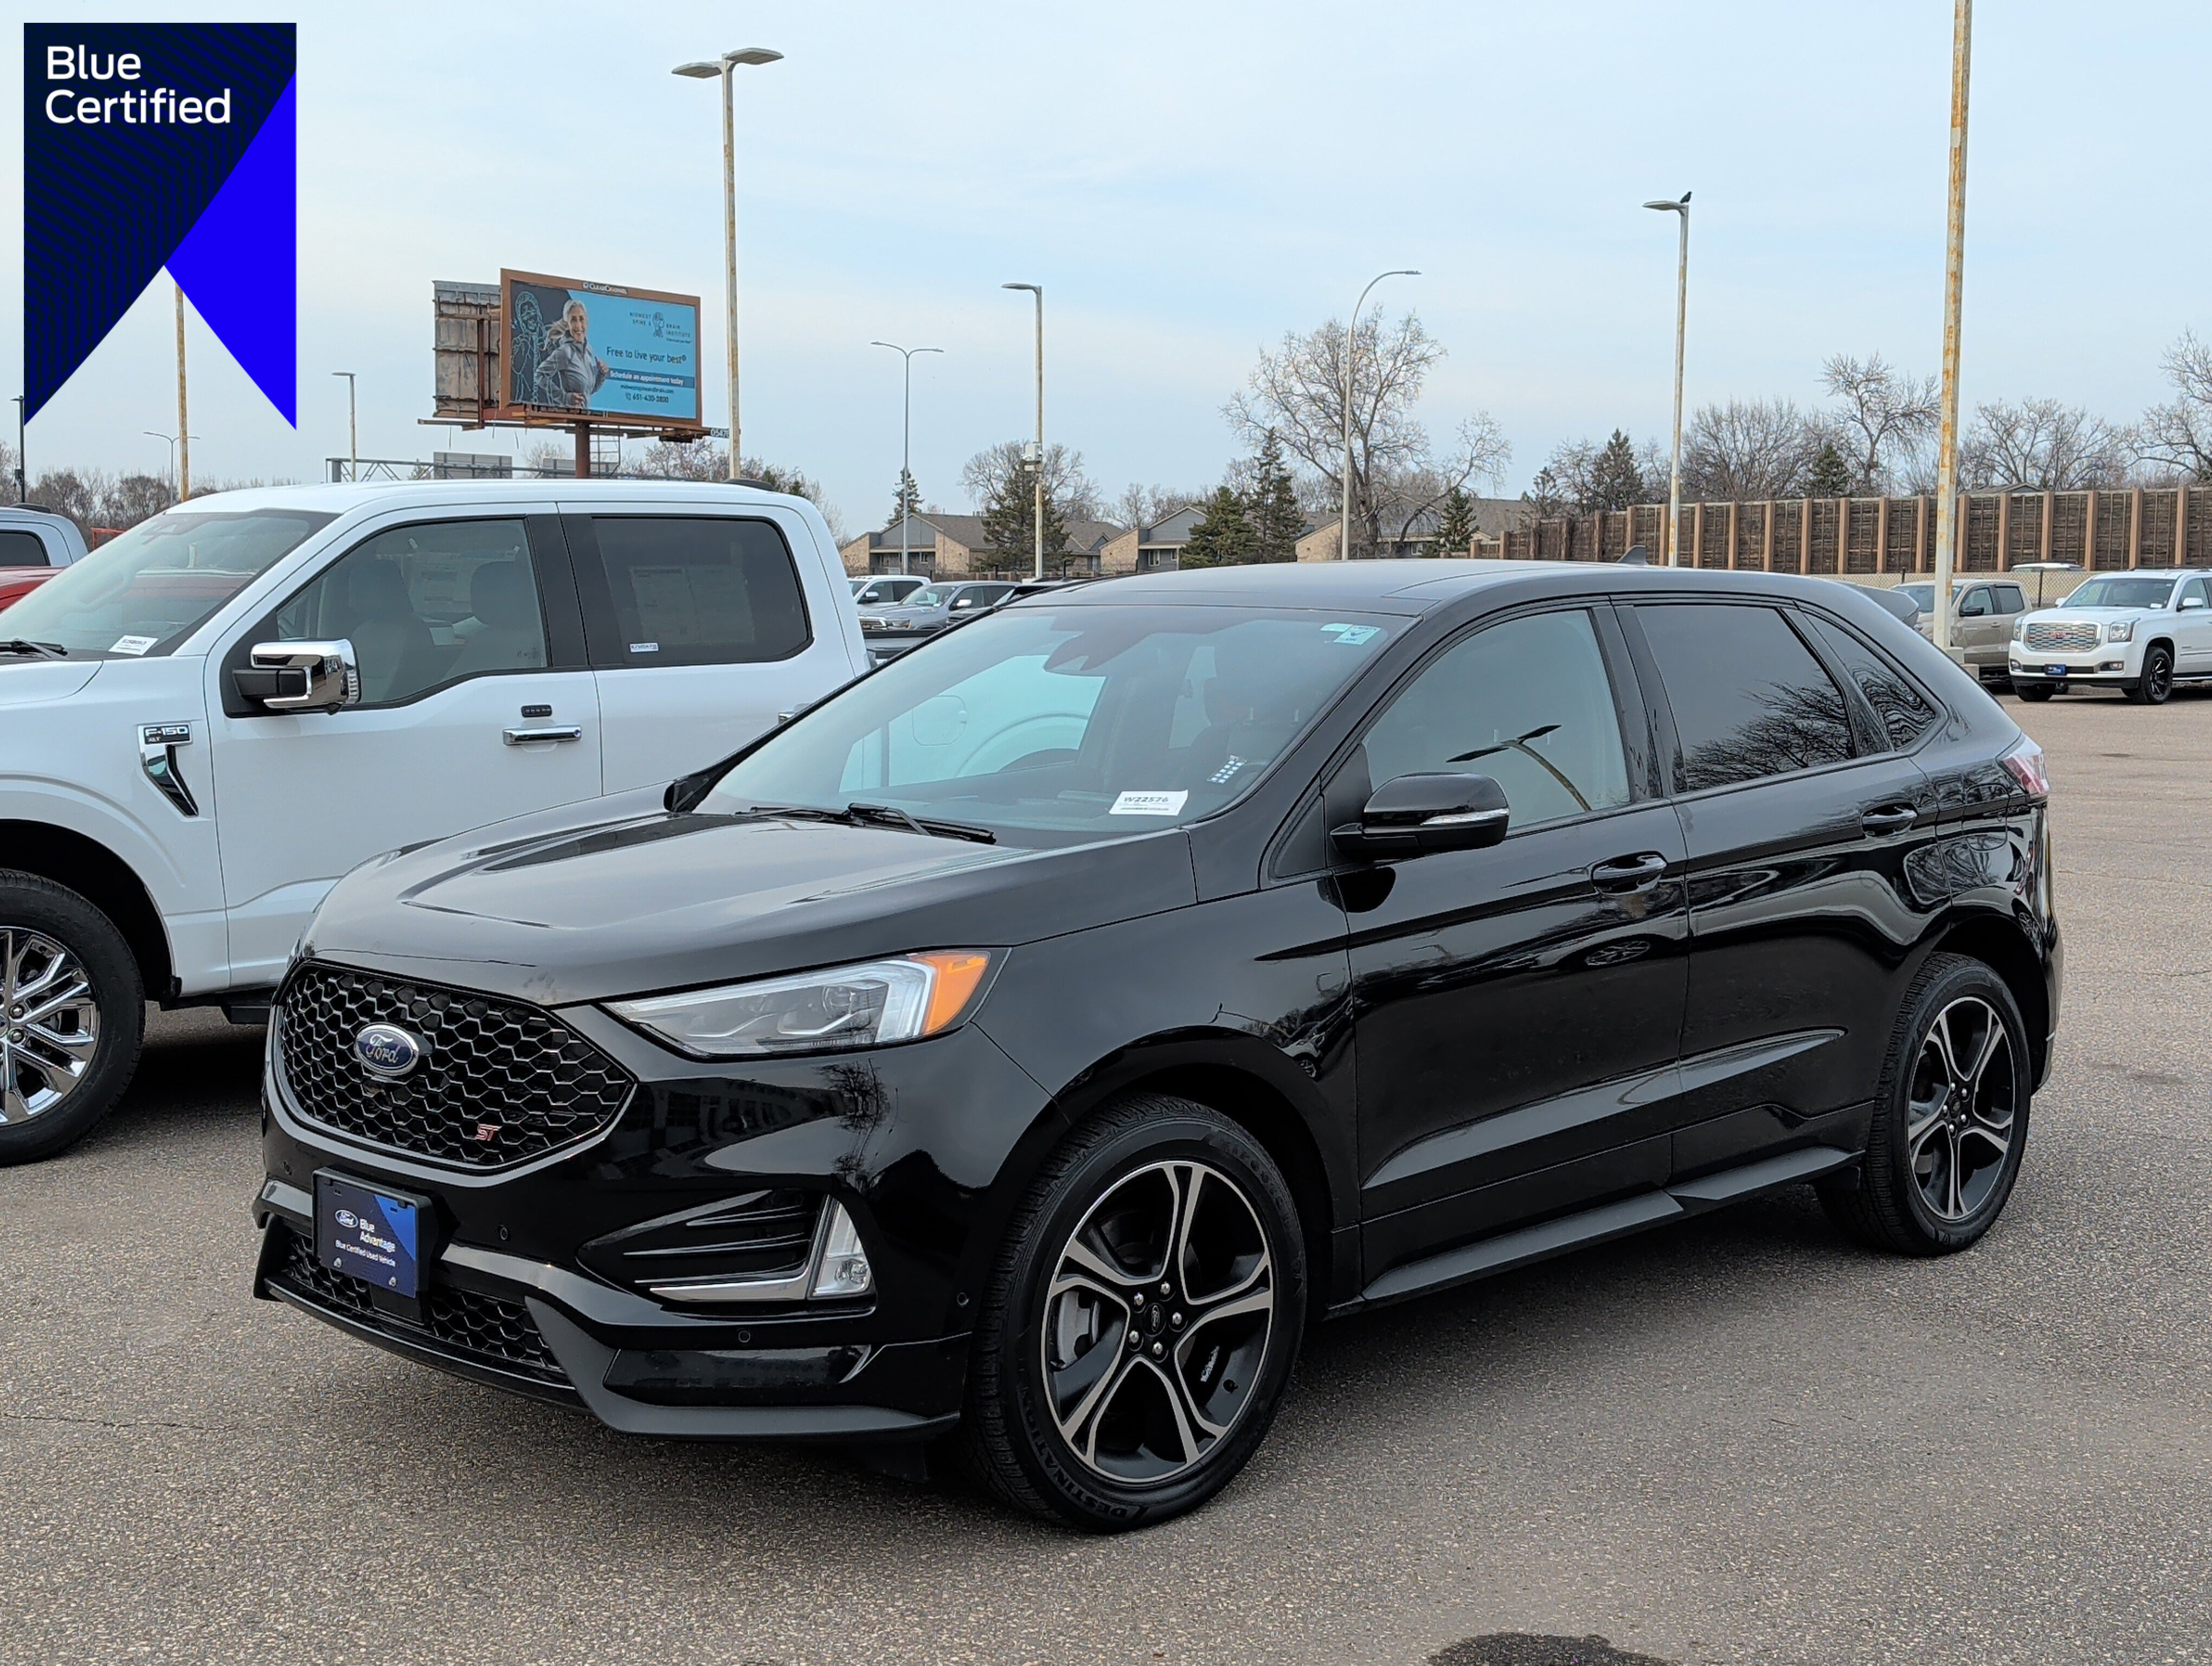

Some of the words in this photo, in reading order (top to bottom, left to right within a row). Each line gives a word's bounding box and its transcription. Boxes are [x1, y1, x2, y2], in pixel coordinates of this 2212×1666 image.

[606, 347, 623, 357] Free
[625, 350, 633, 358] to
[634, 350, 647, 360] live
[650, 354, 665, 363] your
[610, 371, 632, 379] Schedule
[640, 375, 670, 383] appointment
[671, 377, 684, 386] today
[145, 727, 188, 737] F-150
[366, 1034, 401, 1063] Ford
[475, 1124, 502, 1141] ST
[360, 1218, 375, 1233] Blue
[360, 1231, 396, 1253] Advantage
[336, 1239, 346, 1250] Blue
[346, 1244, 366, 1256] Certified
[366, 1251, 378, 1261] Used
[379, 1254, 396, 1267] Vehicle
